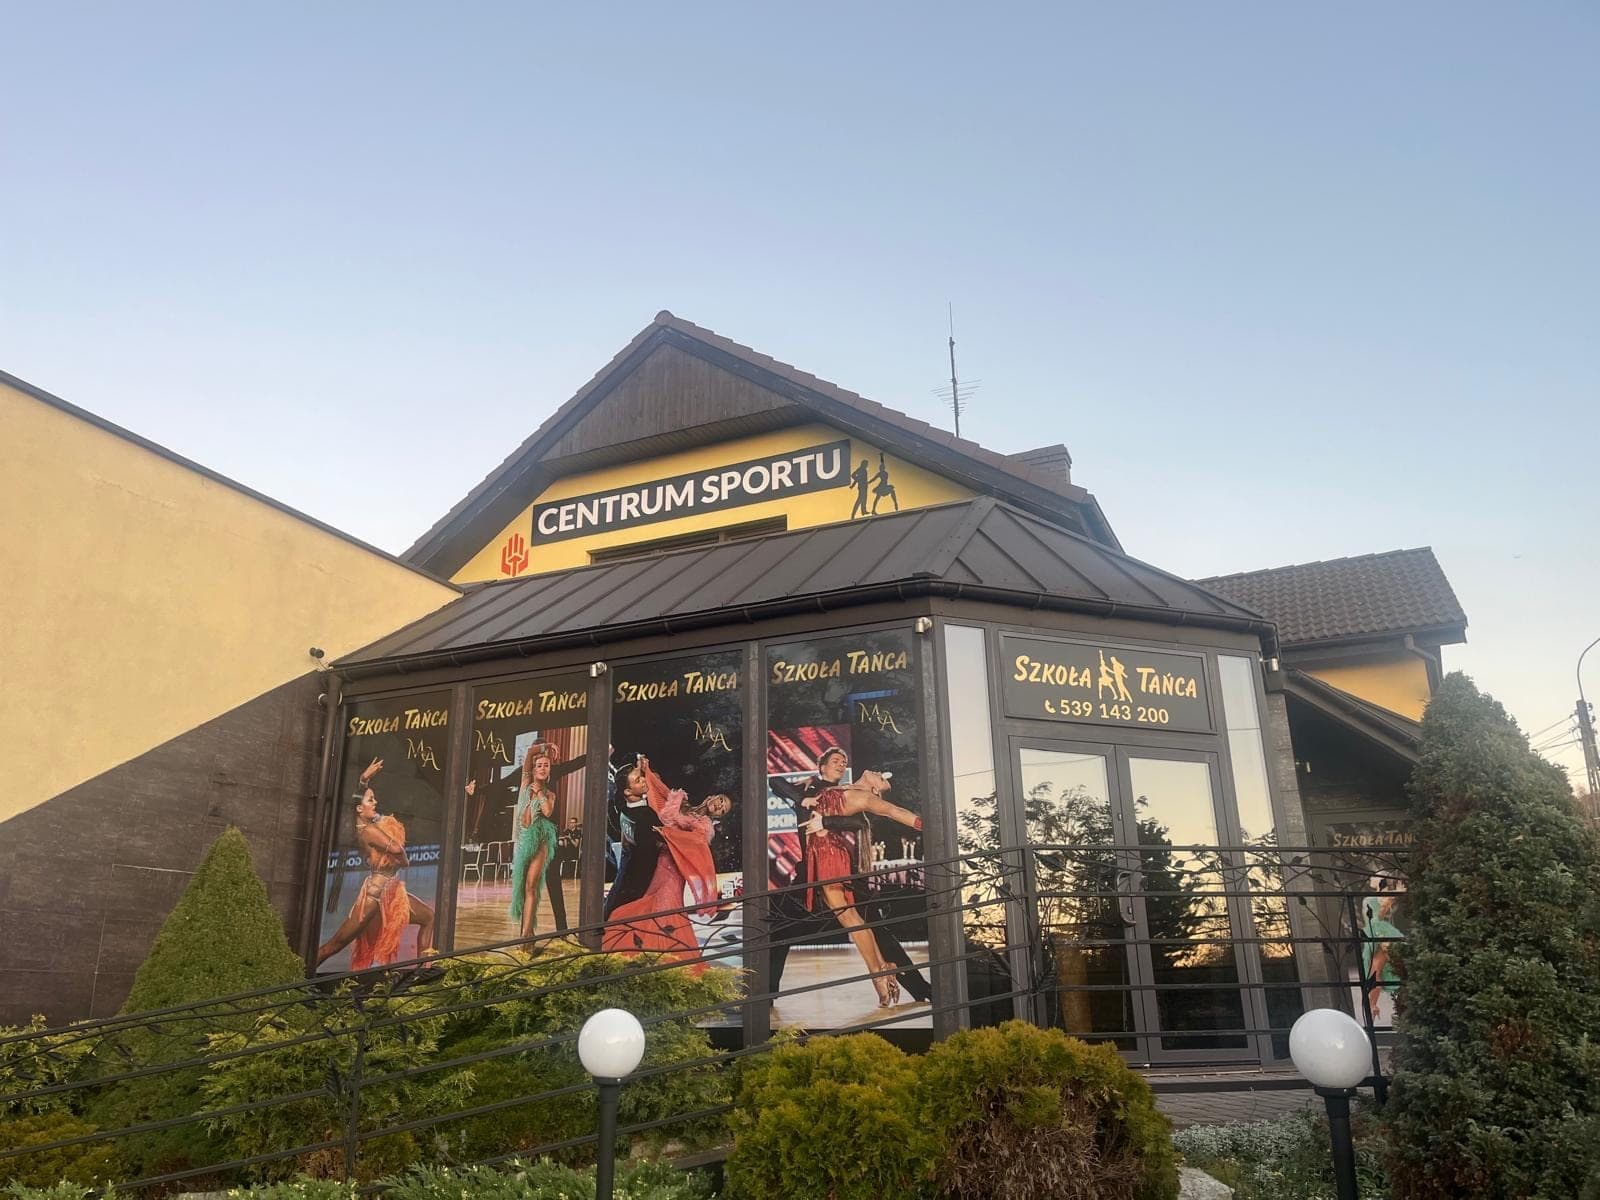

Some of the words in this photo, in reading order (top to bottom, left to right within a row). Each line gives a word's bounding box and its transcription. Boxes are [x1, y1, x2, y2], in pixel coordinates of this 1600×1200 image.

[537, 479, 695, 536] CENTRUM
[701, 448, 841, 504] SPORTU
[771, 659, 840, 685] SZKOŁA
[847, 650, 907, 674] TAŃCA
[1014, 655, 1092, 688] SZKOŁA
[1136, 667, 1197, 698] TAŃCA
[616, 679, 678, 703] SZKOŁA
[684, 671, 737, 694] TAŃCA
[476, 699, 533, 720] SZKOŁA
[539, 691, 587, 712] TAŃCA
[1060, 699, 1093, 717] 539
[1100, 703, 1132, 720] 143
[1137, 706, 1169, 724] 200
[348, 715, 399, 736] SZKOŁA
[404, 708, 449, 729] TAŃCA
